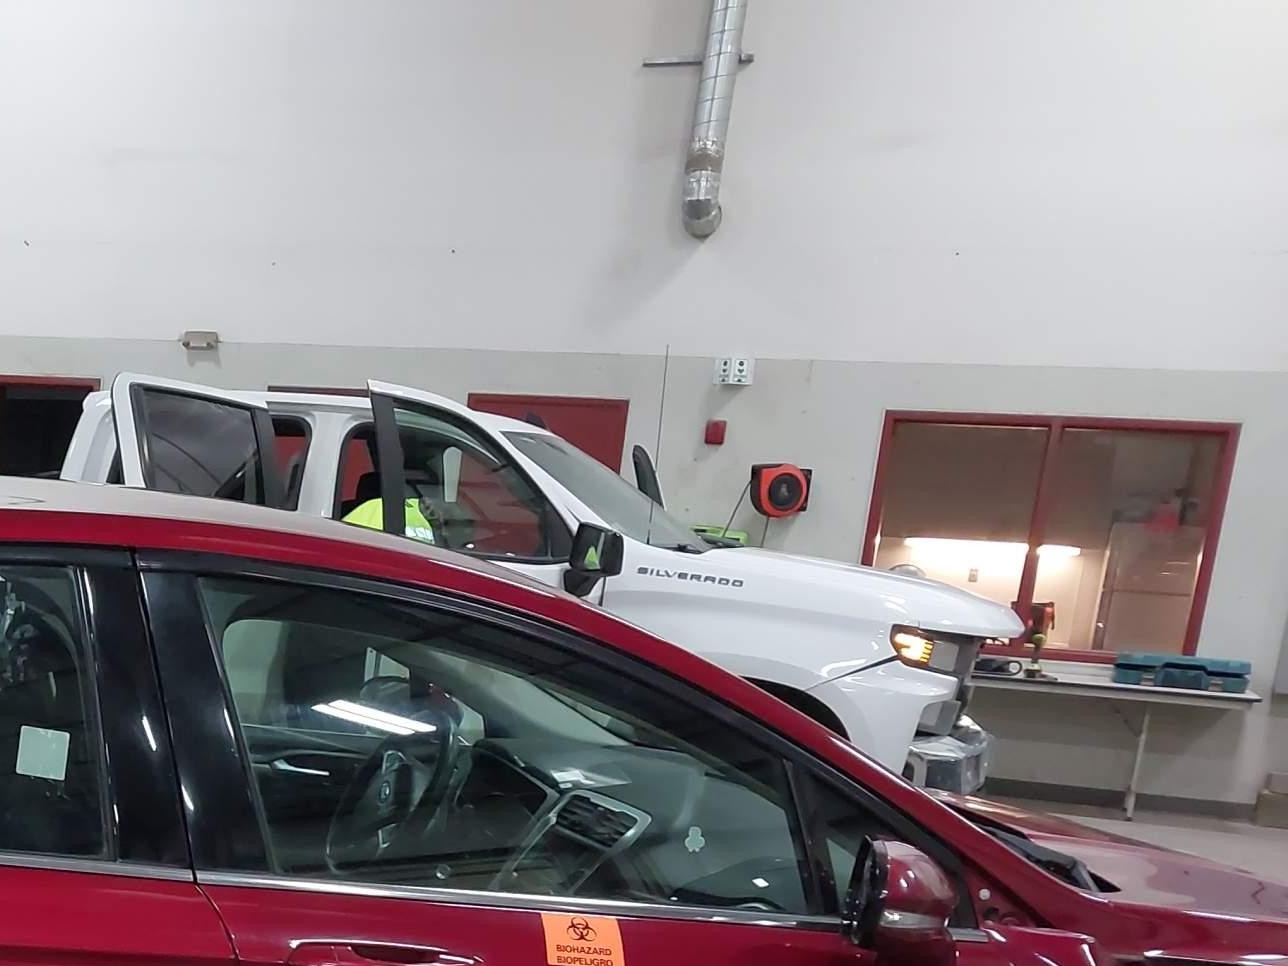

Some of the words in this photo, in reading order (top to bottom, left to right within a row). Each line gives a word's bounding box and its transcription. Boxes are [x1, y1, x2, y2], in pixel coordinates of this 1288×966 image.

[637, 566, 744, 588] SILVERADO
[556, 944, 612, 956] BIOHAZARD
[556, 955, 614, 966] BIOPELIGRO
